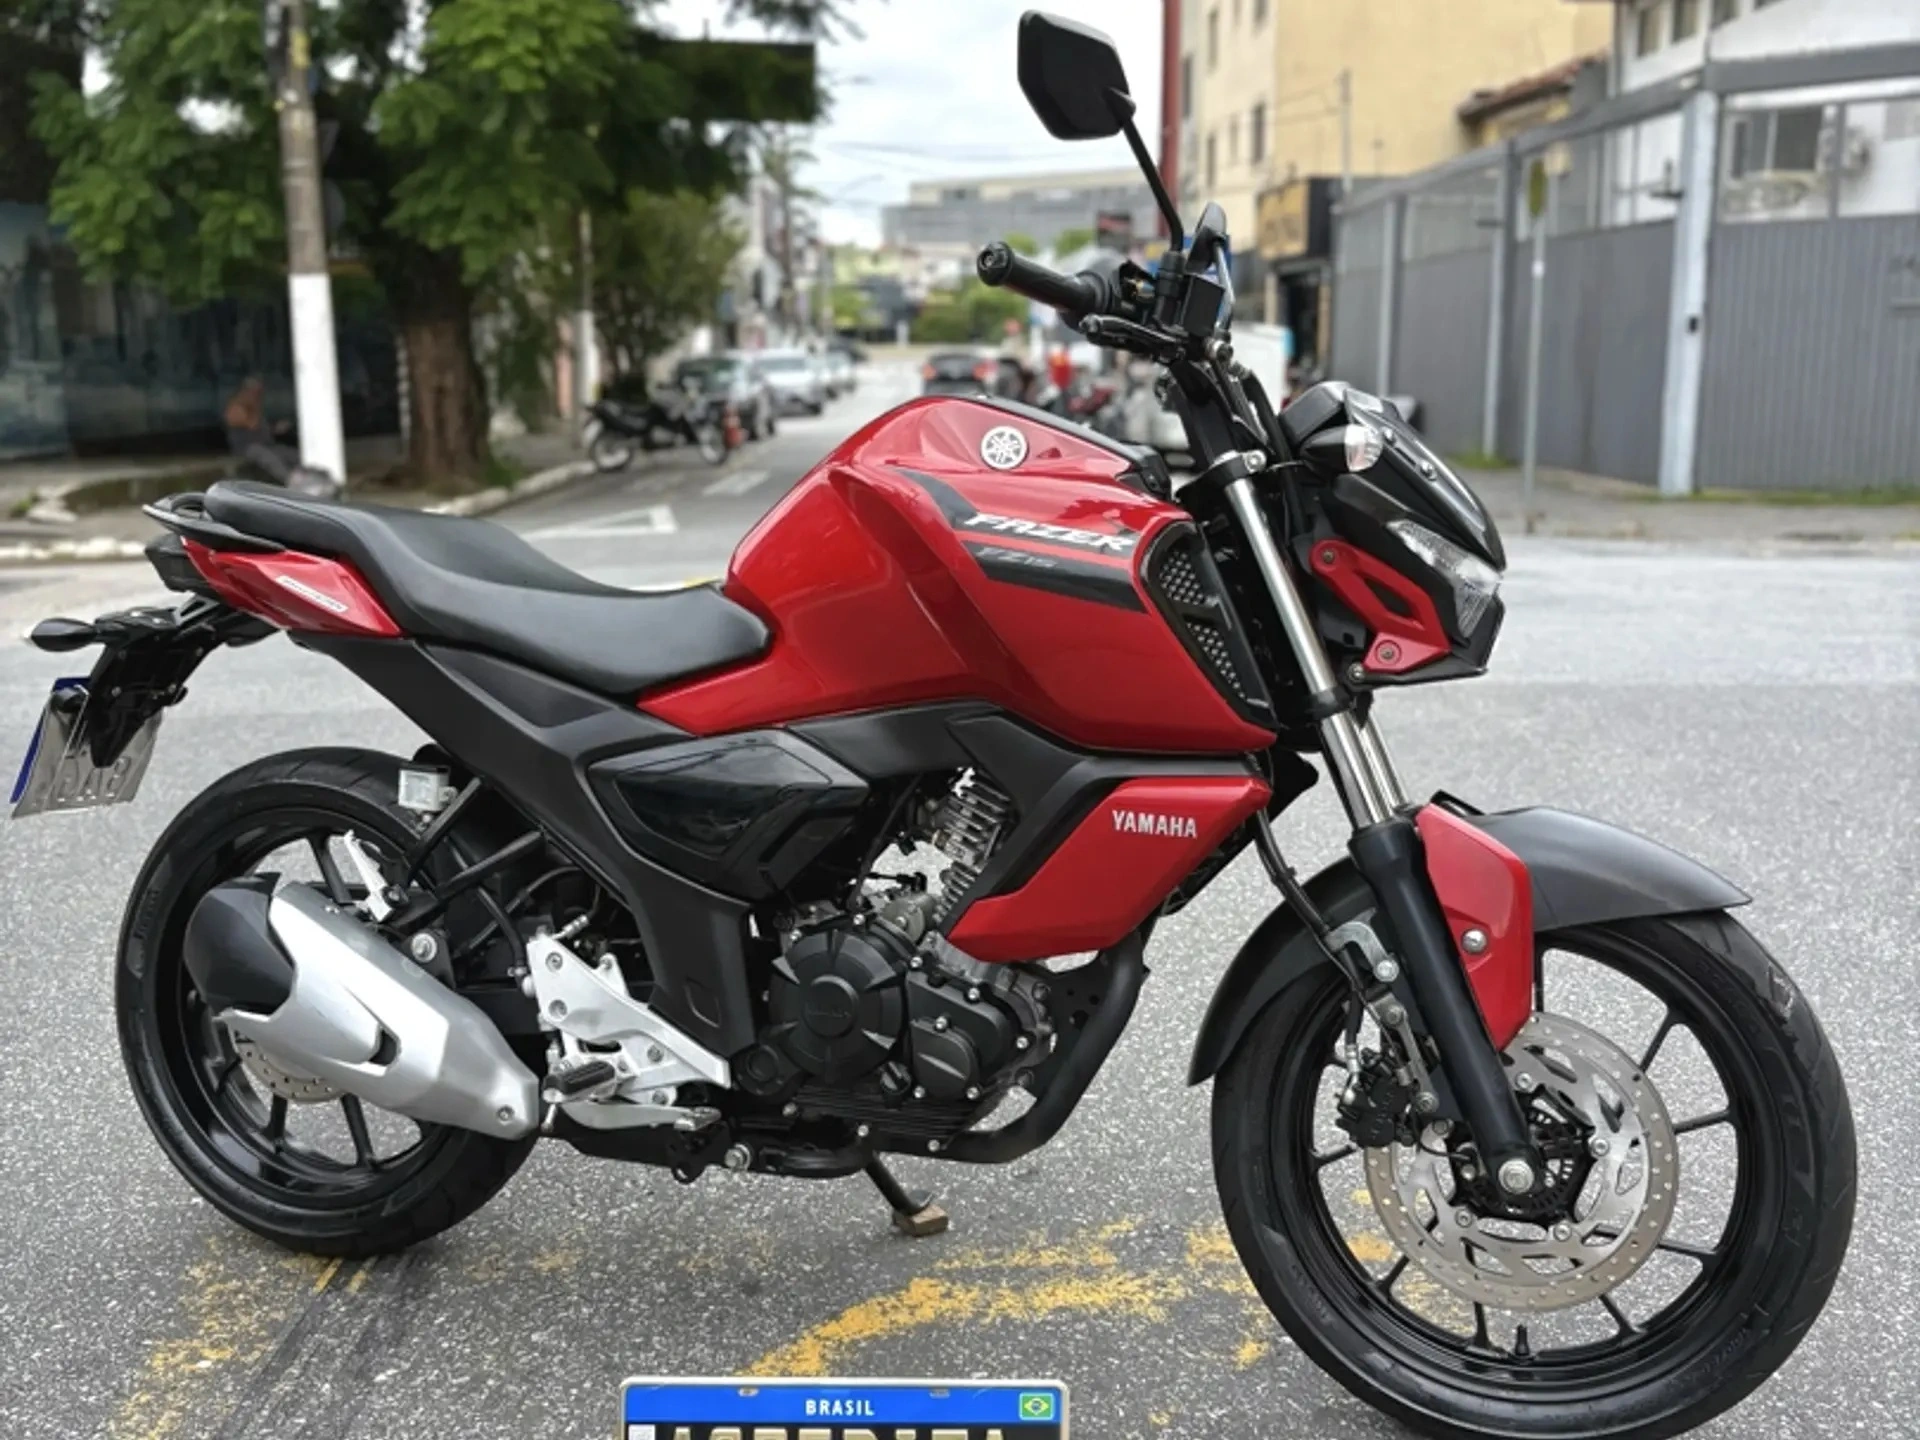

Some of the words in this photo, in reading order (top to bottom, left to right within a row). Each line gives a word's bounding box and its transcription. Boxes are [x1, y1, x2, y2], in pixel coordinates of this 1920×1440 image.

[963, 512, 1138, 551] FAZER
[1111, 809, 1198, 839] YAMAHA
[805, 1399, 875, 1416] BRASIL
